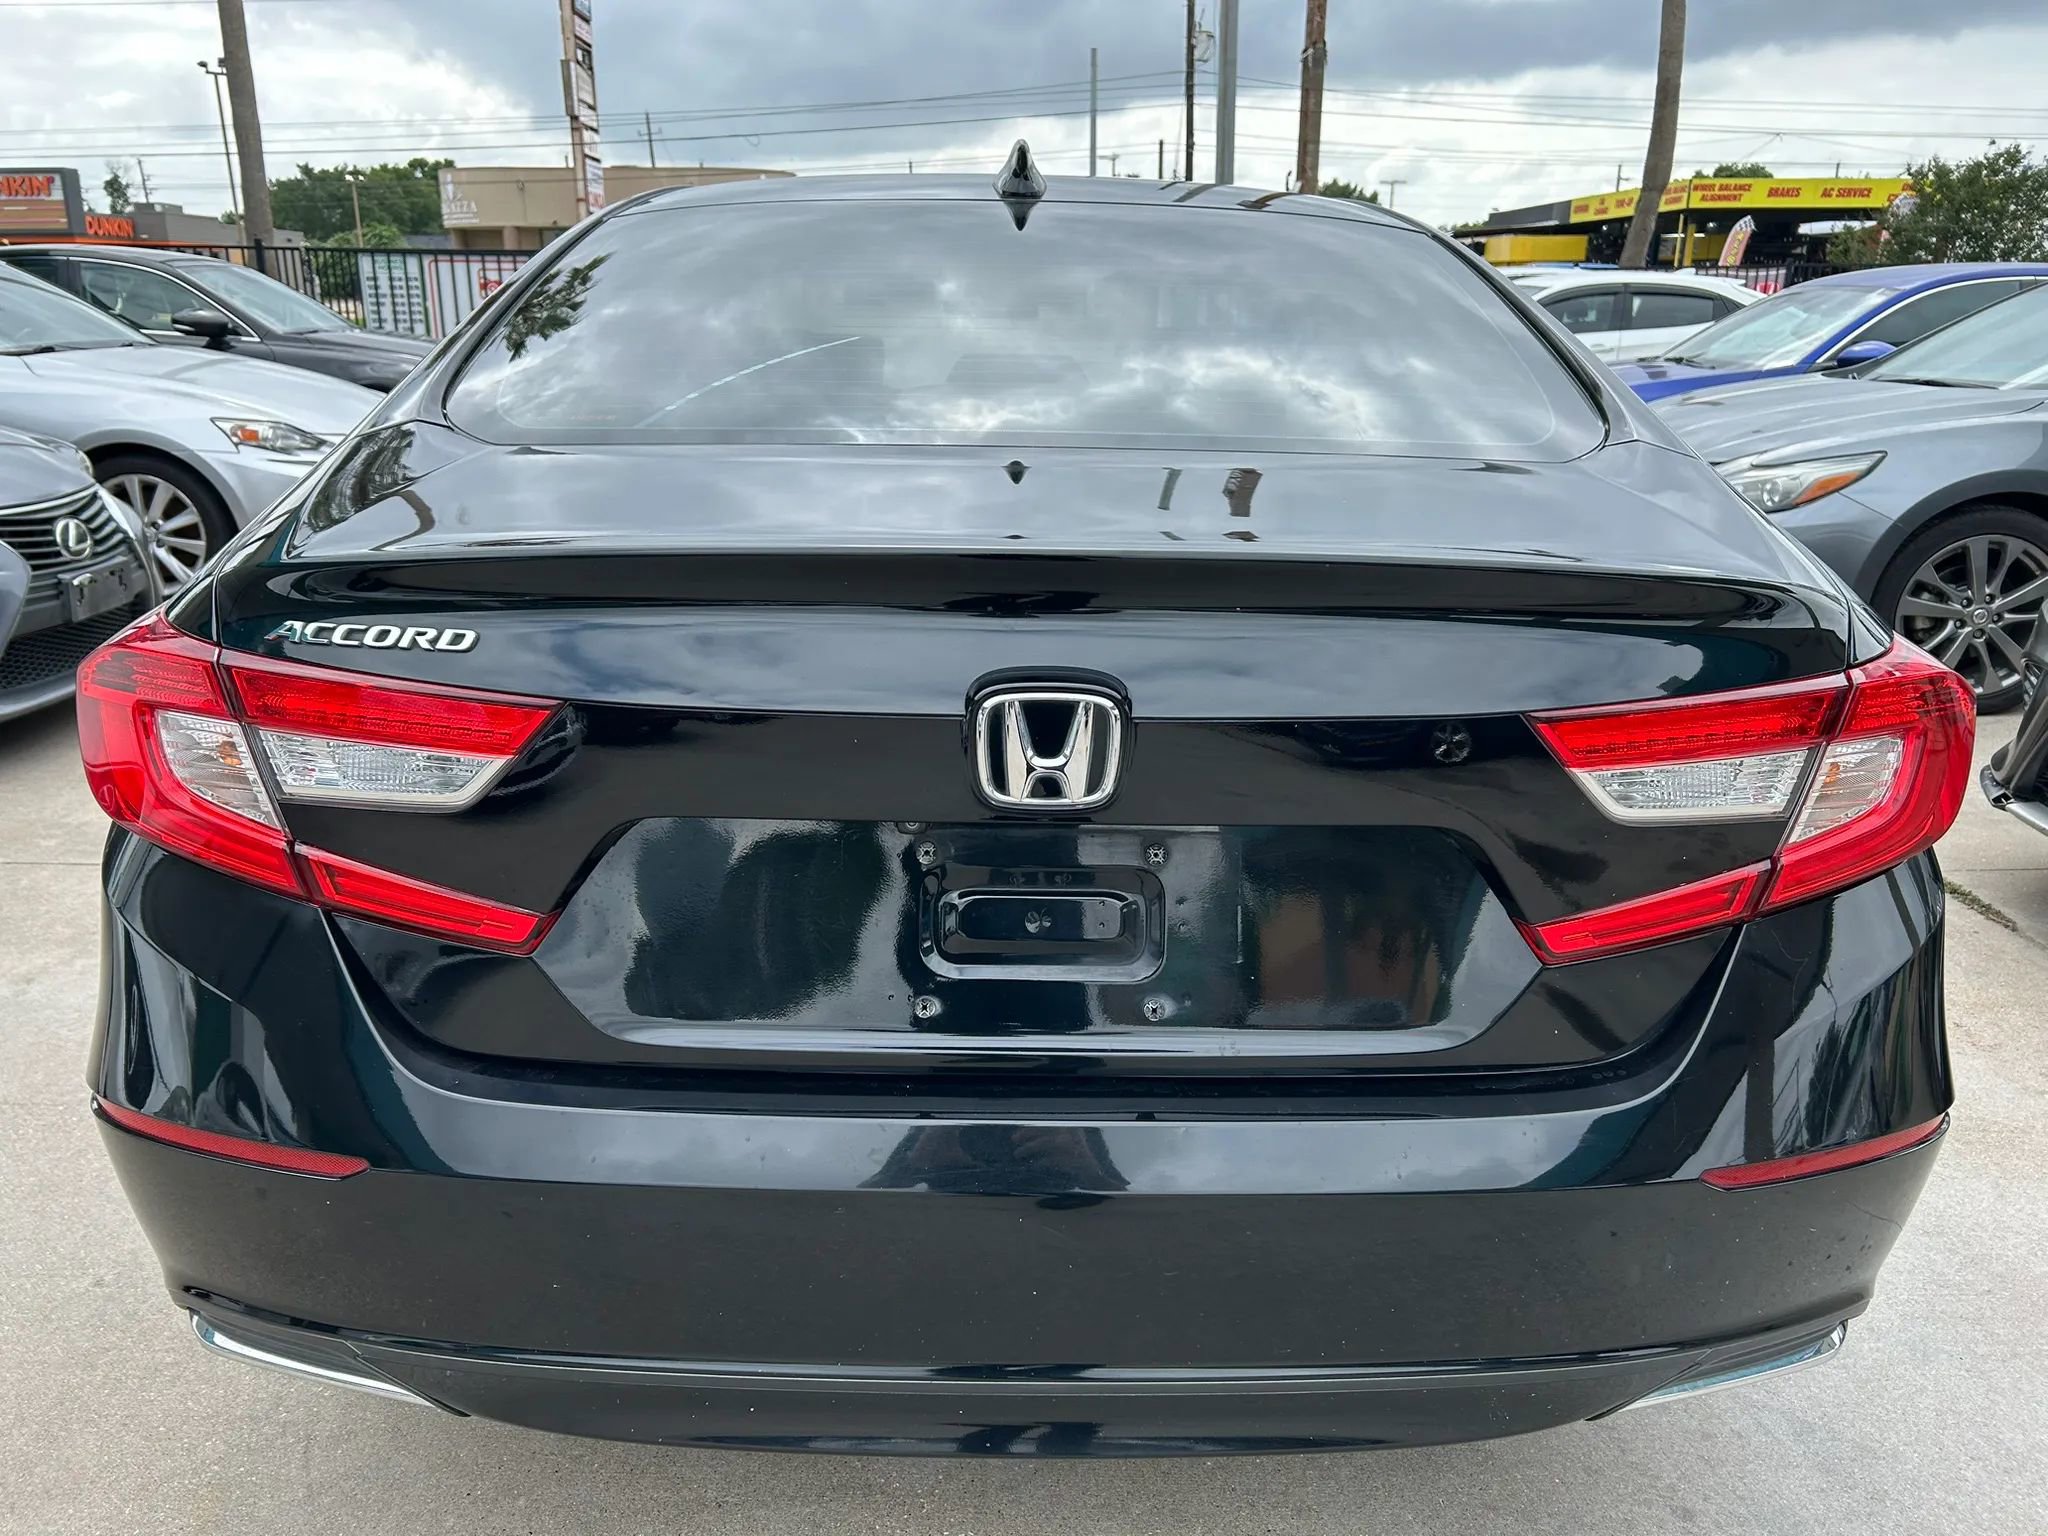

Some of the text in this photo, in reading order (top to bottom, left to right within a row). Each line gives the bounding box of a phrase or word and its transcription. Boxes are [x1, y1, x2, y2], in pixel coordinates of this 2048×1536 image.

[1718, 183, 1752, 192] BALANCE
[1766, 187, 1802, 198] BRAKES
[1821, 187, 1835, 198] AC
[1836, 187, 1873, 198] SERVICE
[1700, 193, 1744, 202] ALIGNMENT
[264, 620, 479, 652] ACCORD
